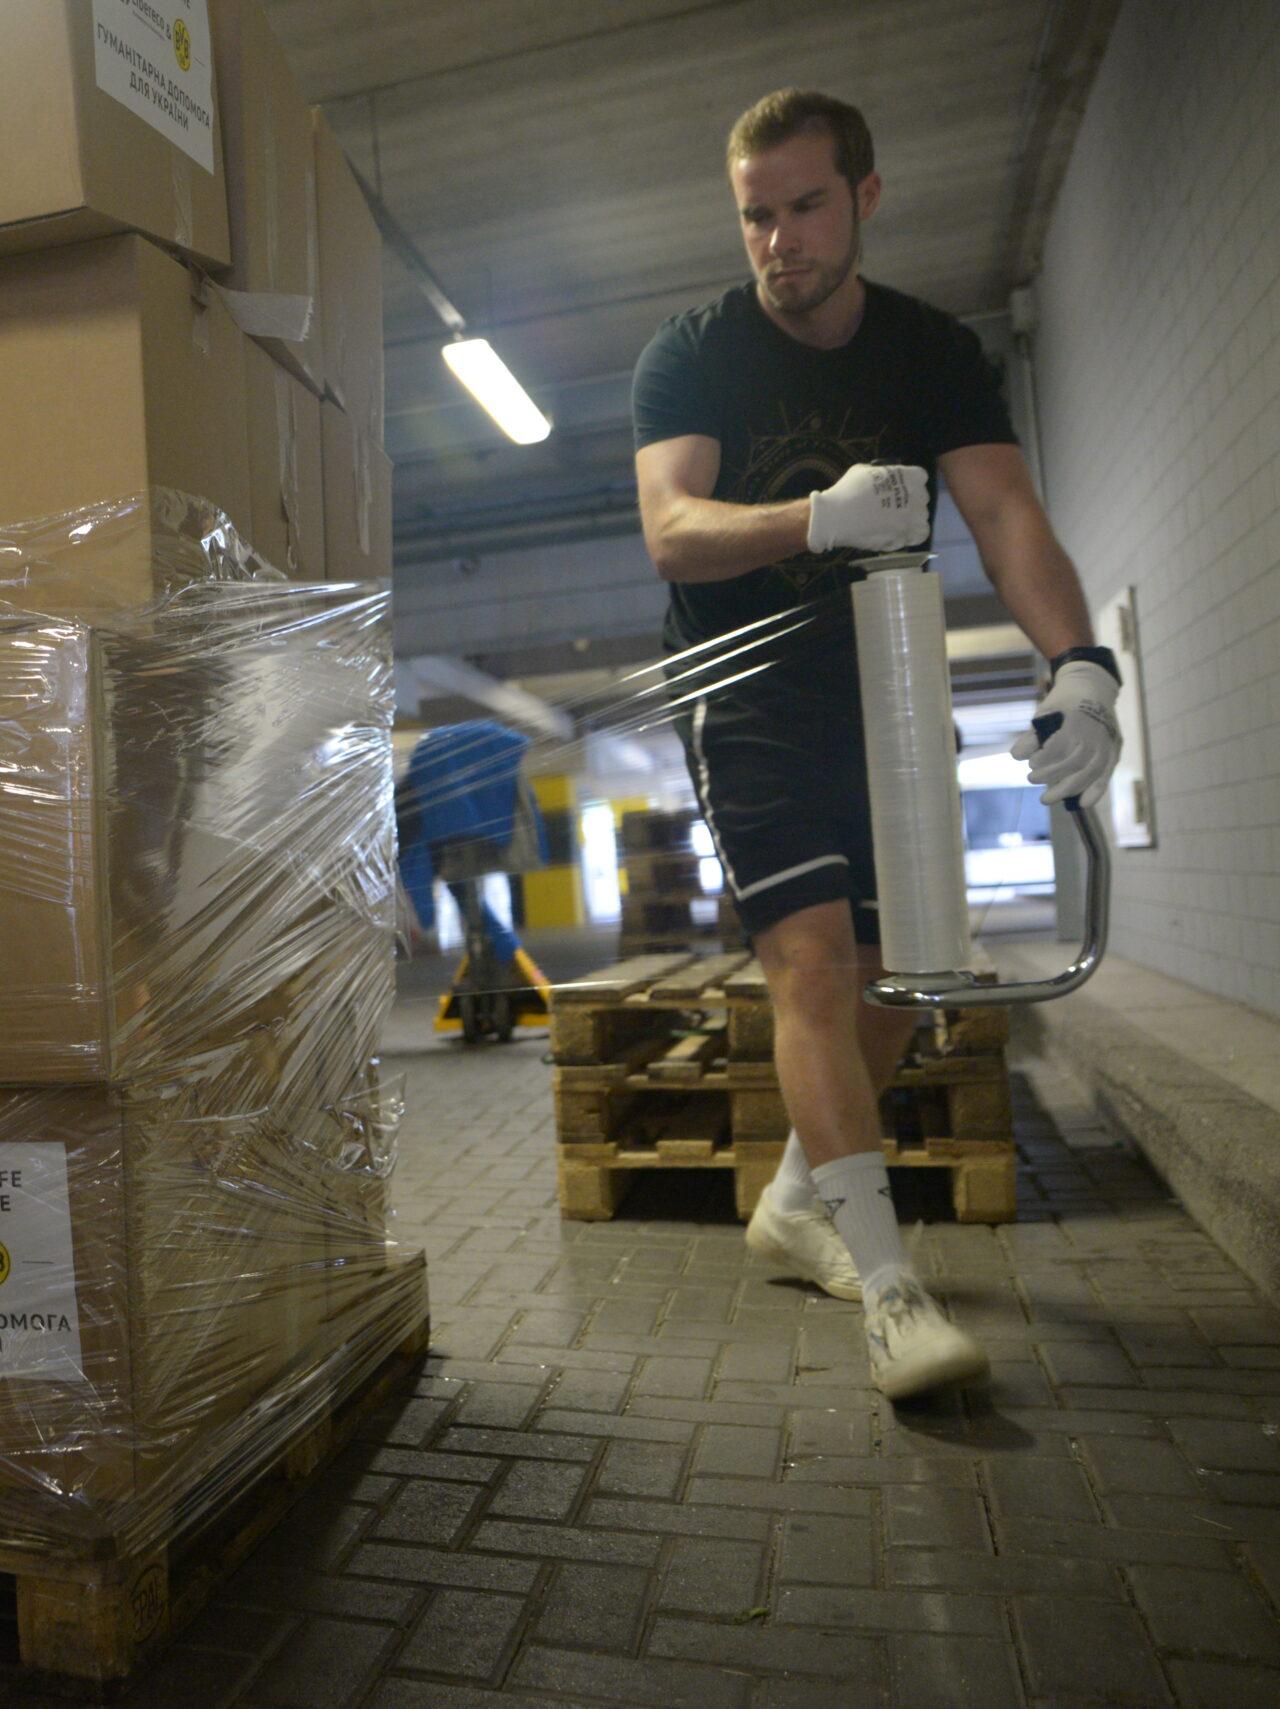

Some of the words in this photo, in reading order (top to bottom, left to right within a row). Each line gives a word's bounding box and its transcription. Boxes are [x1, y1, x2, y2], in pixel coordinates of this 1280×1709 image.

[97, 23, 166, 87] ГУМАНІТАРНА
[168, 81, 210, 129] ДОПОМОГА
[130, 71, 150, 100] ДЛЯ
[152, 88, 189, 131] УКРАЇНИ
